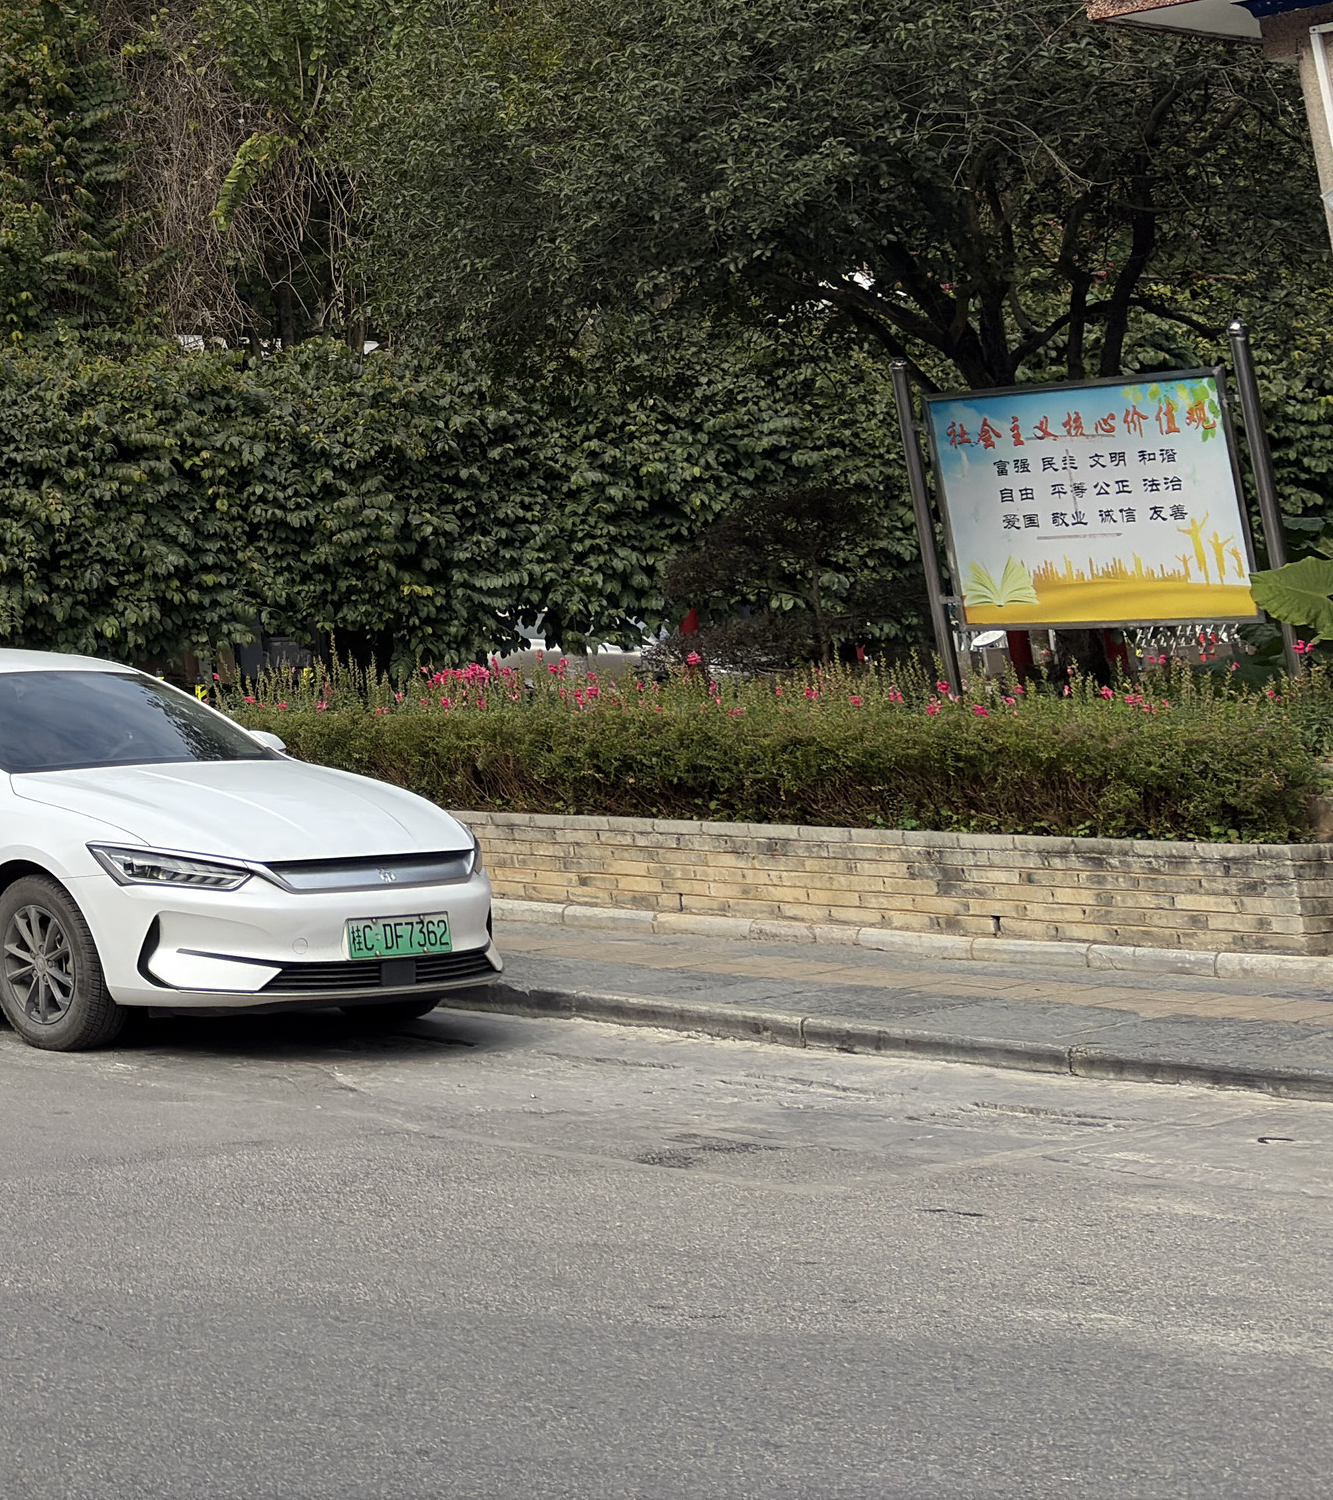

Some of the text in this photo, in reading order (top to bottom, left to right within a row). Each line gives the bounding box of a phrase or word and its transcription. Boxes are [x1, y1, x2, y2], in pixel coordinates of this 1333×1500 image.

[946, 400, 1217, 449] 社会主义核心价值观
[993, 448, 1177, 476] 富强 民主 文明 和谐
[999, 476, 1182, 503] 自由 平等 公正 法治
[1002, 504, 1188, 530] 爱国 敬业 诚信 友善
